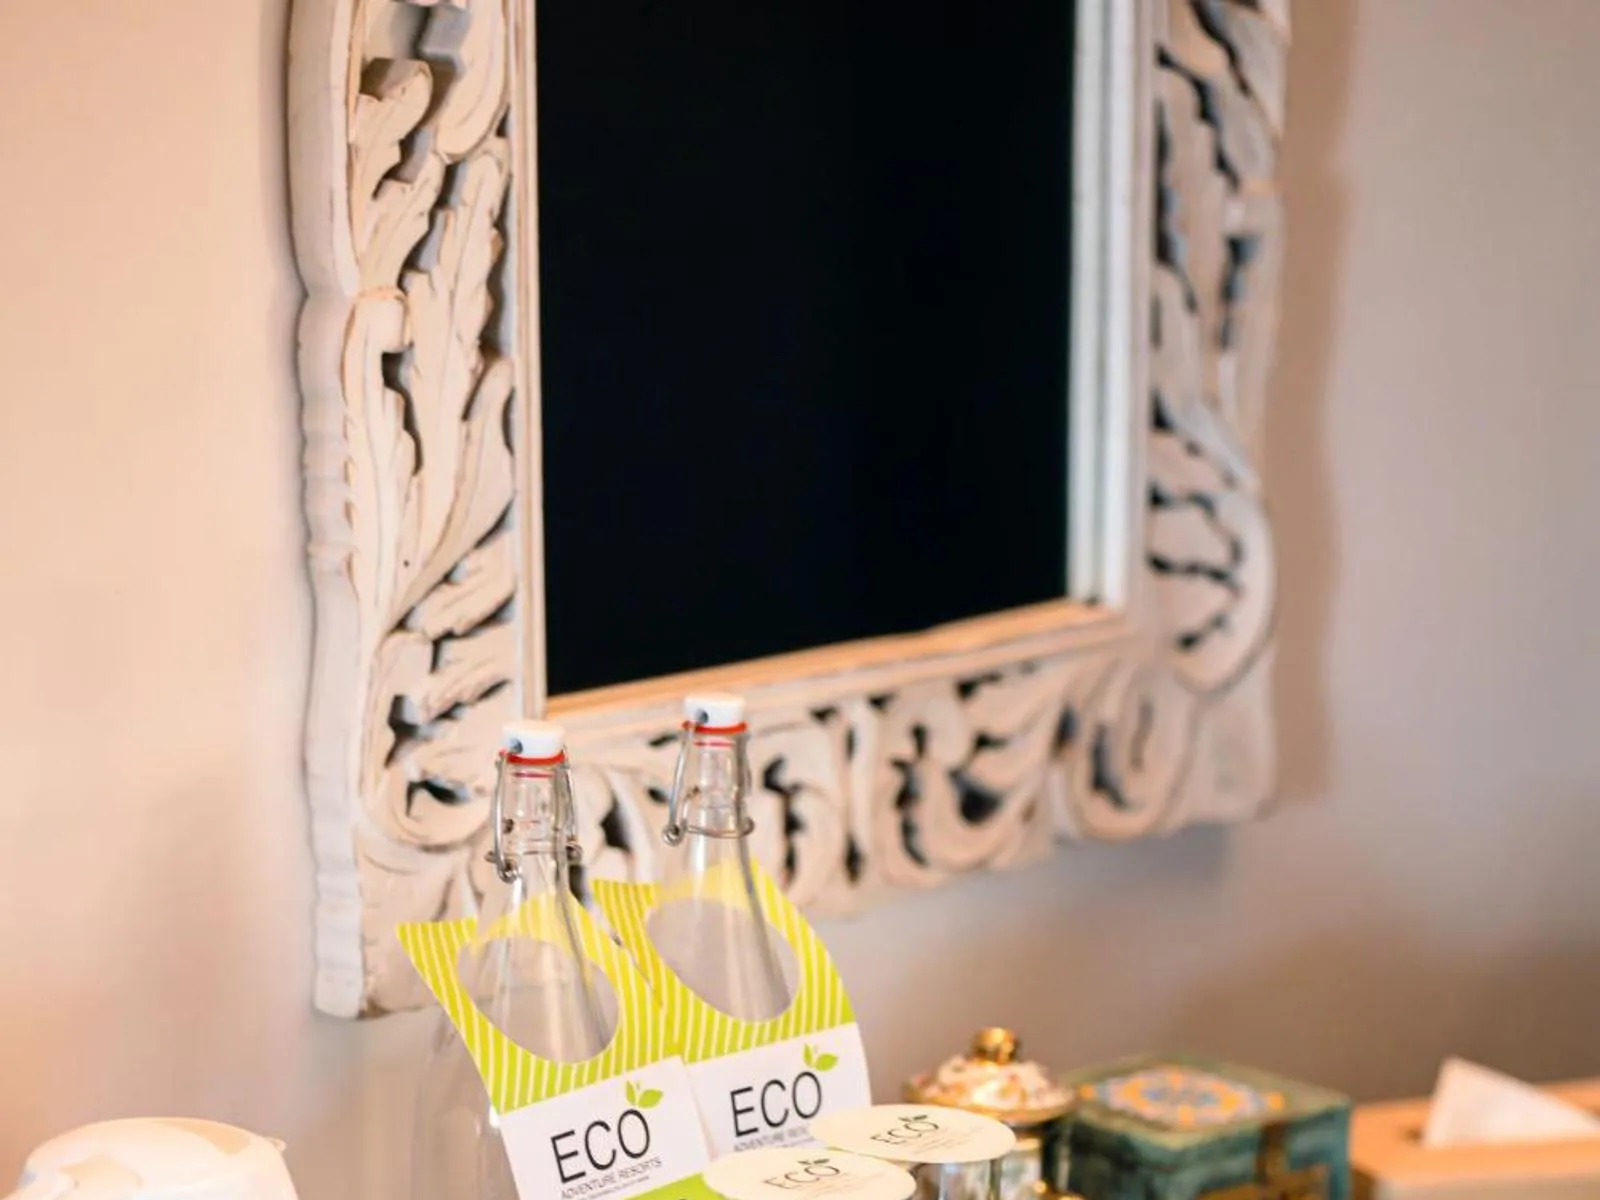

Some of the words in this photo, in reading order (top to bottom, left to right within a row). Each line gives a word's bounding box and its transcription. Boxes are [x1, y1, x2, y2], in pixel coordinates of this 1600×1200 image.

[730, 1071, 822, 1137] ECO
[550, 1109, 650, 1183] ECO
[870, 1121, 939, 1145] ECO
[561, 1173, 617, 1200] ADVENTURE
[762, 1165, 840, 1190] ECO
